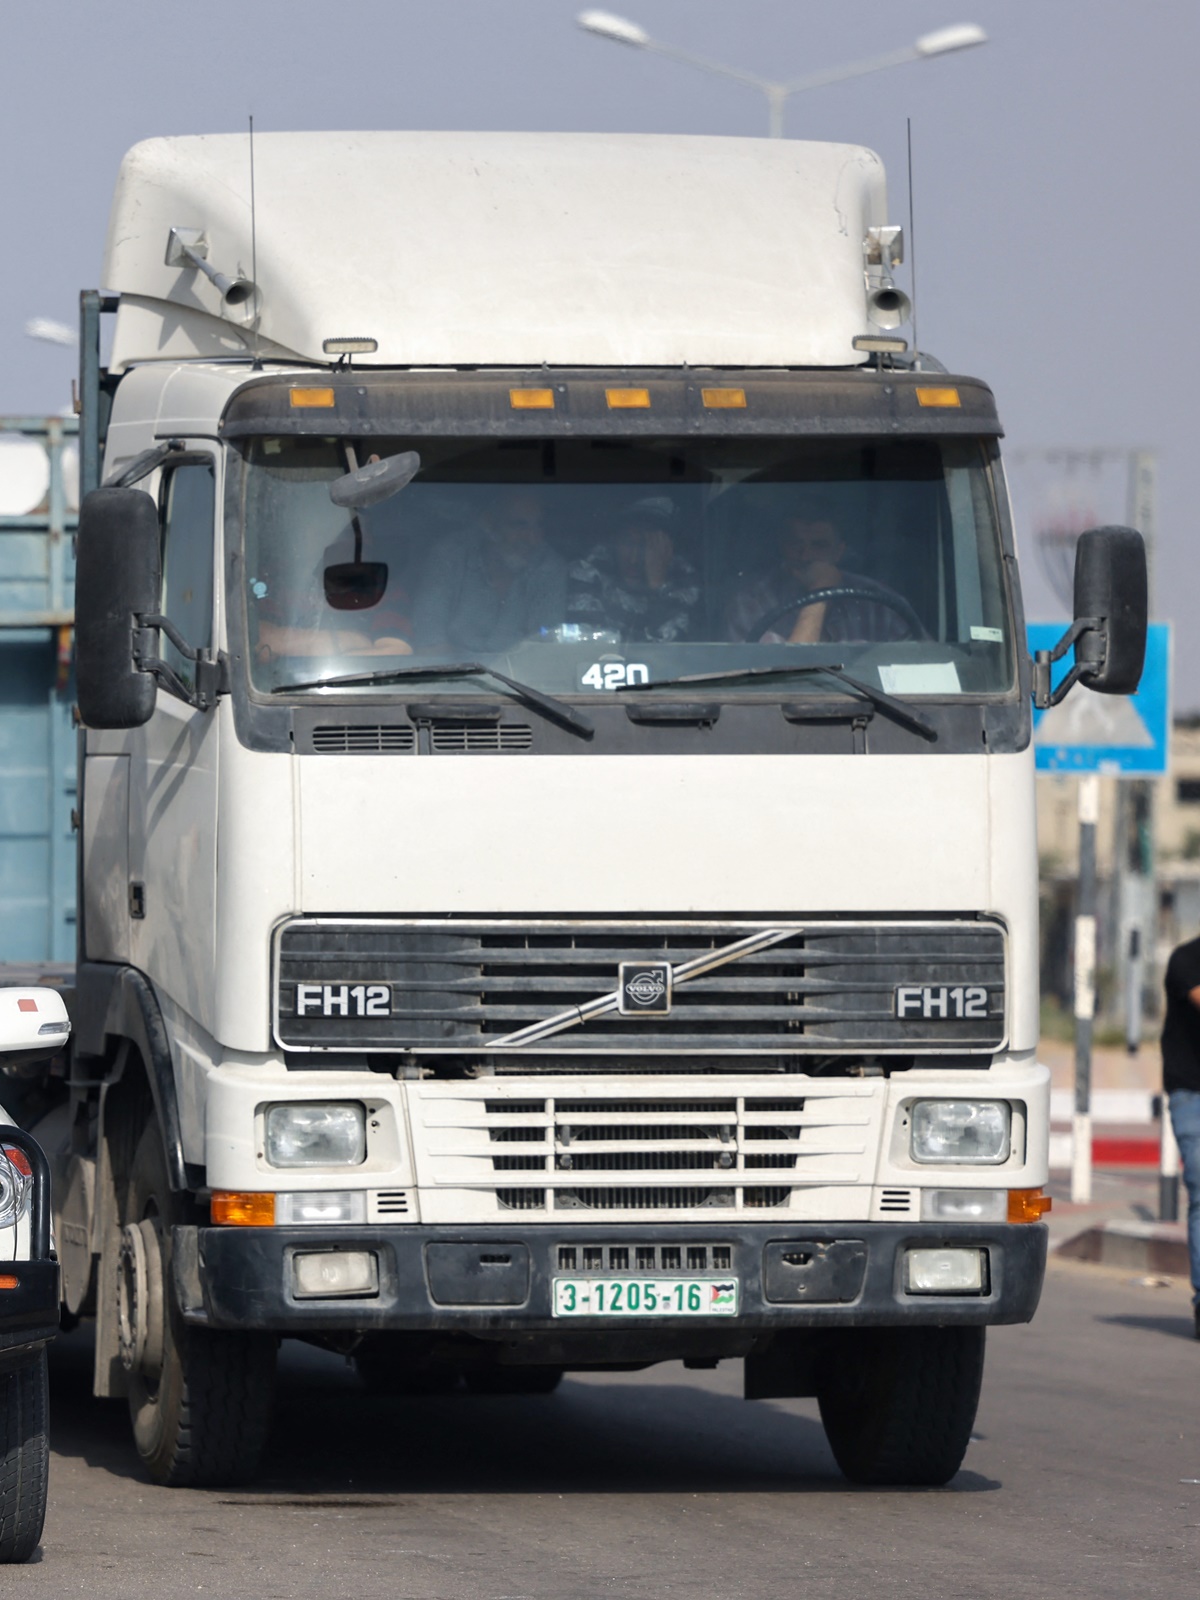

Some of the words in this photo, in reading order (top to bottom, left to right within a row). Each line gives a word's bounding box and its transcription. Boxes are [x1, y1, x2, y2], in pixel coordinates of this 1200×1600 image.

[581, 663, 649, 689] 420
[297, 984, 390, 1016] FH12
[628, 984, 663, 993] VOLVO
[897, 987, 988, 1018] FH12
[563, 1283, 701, 1311] 3-1205-16
